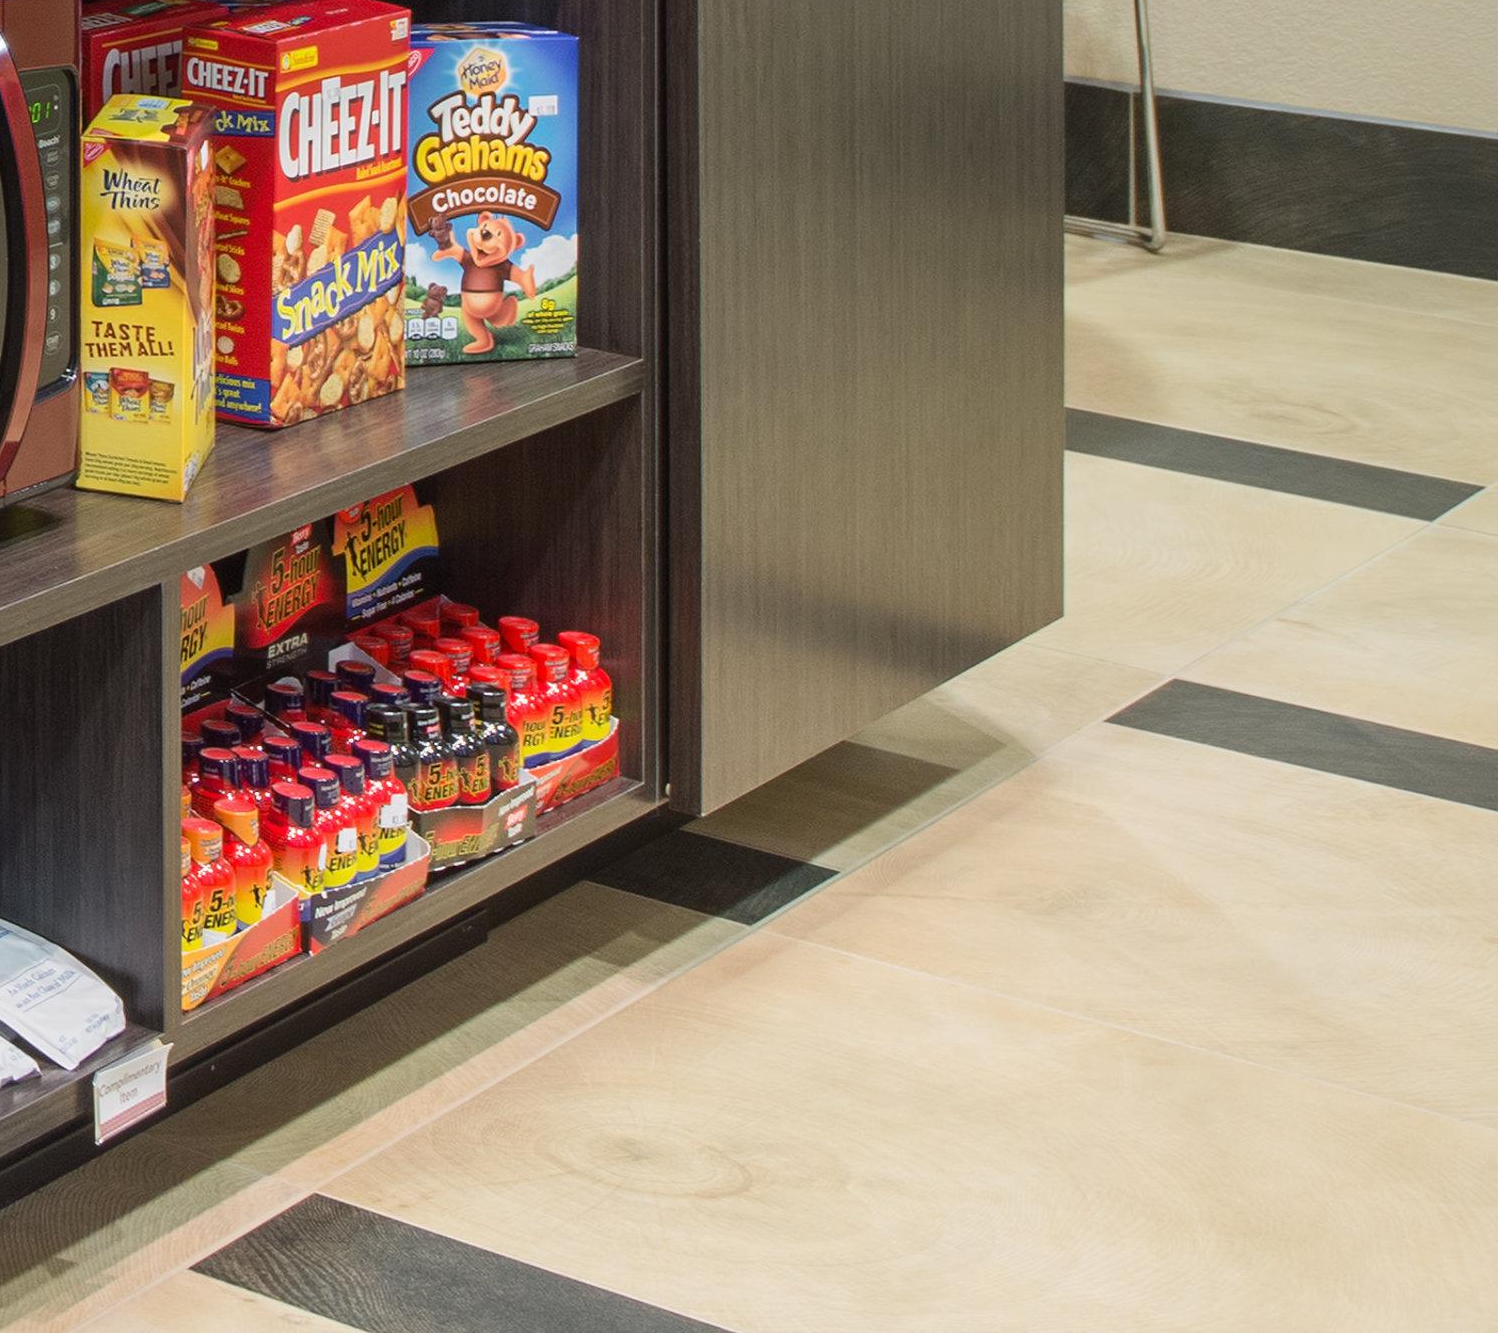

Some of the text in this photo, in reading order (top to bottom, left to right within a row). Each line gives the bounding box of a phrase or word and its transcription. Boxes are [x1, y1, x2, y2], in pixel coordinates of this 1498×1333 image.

[186, 56, 270, 97] CHEEZ-IT
[277, 69, 408, 180] CHEEZ-IT
[429, 94, 536, 143] Teddy
[415, 137, 550, 185] Grahams
[102, 169, 162, 195] Wheat
[104, 188, 161, 212] Thins
[431, 187, 538, 215] Chocolate
[277, 240, 401, 343] Snack Mix
[84, 337, 176, 360] THEM ALL!
[90, 320, 158, 344] TASTE
[360, 495, 406, 543] 5-hour
[270, 545, 322, 587] 5-hour
[359, 527, 408, 578] ENERGY
[264, 575, 320, 630] ENERGY
[267, 633, 310, 658] EXTRA
[119, 1087, 140, 1104] Item
